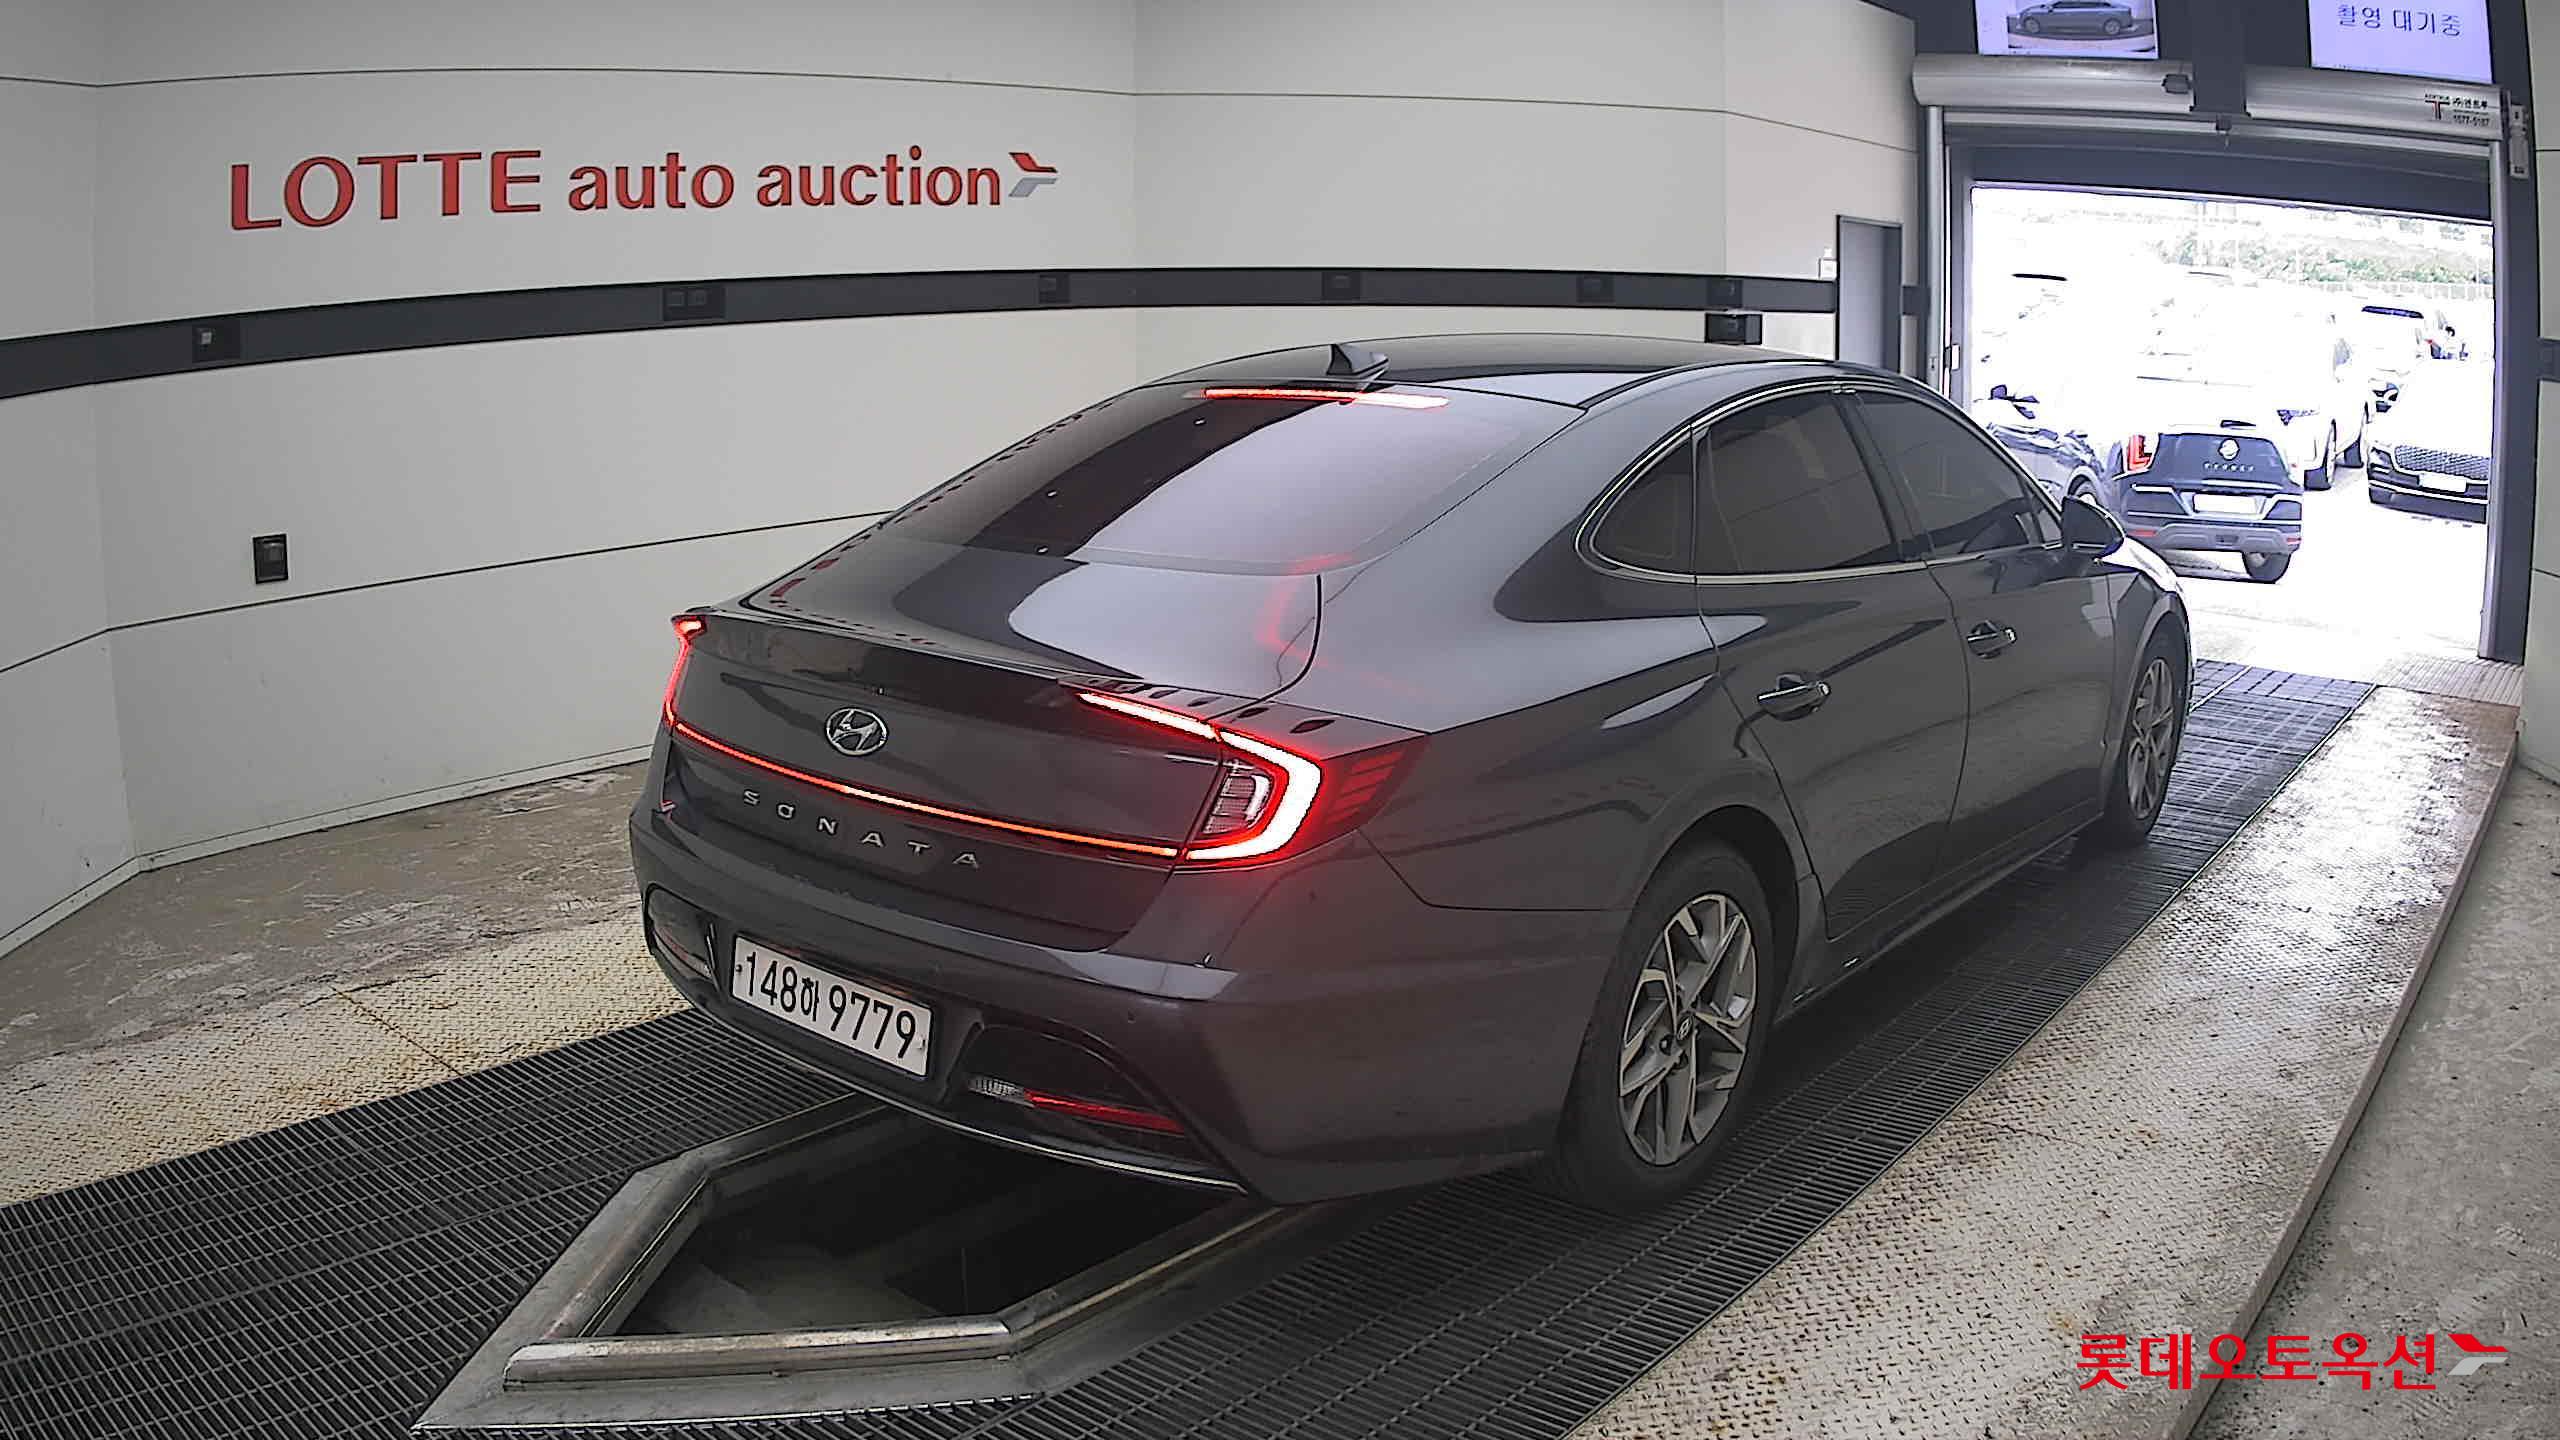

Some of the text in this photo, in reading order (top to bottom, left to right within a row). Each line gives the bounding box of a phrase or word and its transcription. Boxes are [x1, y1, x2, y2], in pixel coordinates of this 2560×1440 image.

[2392, 9, 2461, 38] 대기중
[231, 146, 1002, 231] LOTTE auto auction
[743, 789, 980, 870] SONATA
[746, 951, 916, 1059] 148하 9779
